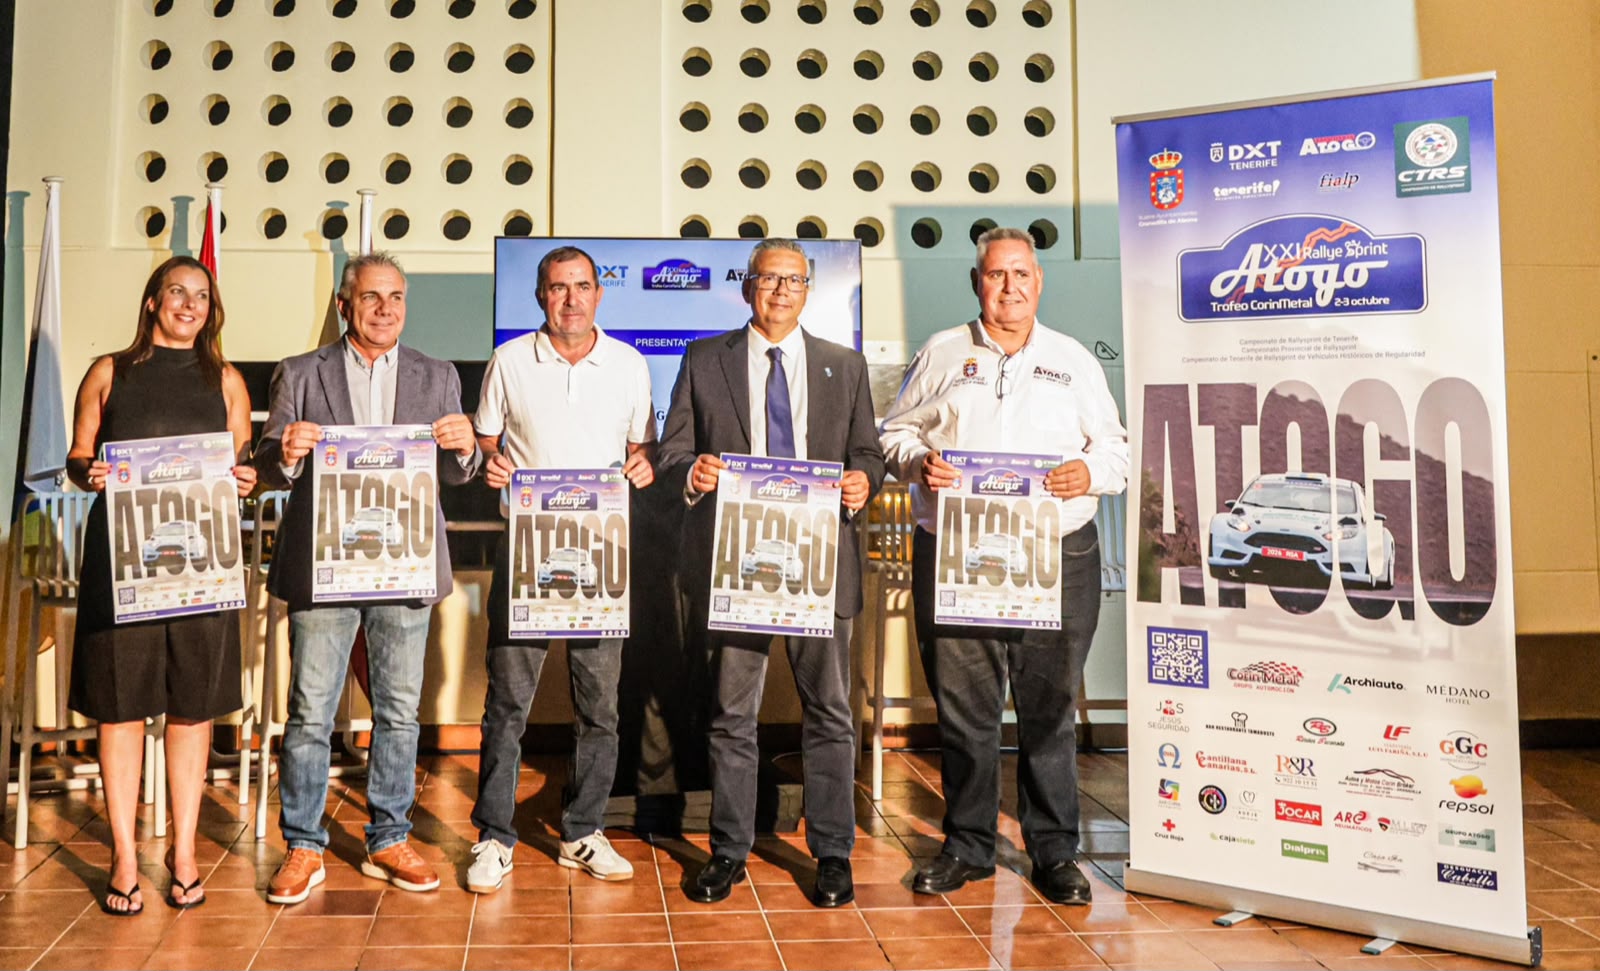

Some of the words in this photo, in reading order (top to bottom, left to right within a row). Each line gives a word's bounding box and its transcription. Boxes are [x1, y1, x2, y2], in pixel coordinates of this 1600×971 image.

[1228, 141, 1281, 161] DXT
[1229, 159, 1278, 171] TENERIFE
[1398, 165, 1468, 183] CTRS
[1213, 180, 1280, 198] tenerife!
[1319, 171, 1359, 189] fialp
[1264, 243, 1300, 261] XXI
[1303, 244, 1342, 261] Rallye
[1345, 242, 1388, 258] Sprint
[651, 265, 702, 287] Atogo
[1209, 243, 1389, 307] Atogo
[1210, 301, 1248, 312] Trofeo
[1250, 297, 1312, 310] CorinMetal
[1334, 298, 1349, 306] 2-3
[1351, 296, 1390, 305] octubre
[1239, 338, 1277, 346] Campeonato
[1288, 336, 1321, 345] Rallysprint
[1323, 344, 1357, 352] Rallysprint
[1181, 356, 1218, 364] Campeonato
[1263, 354, 1296, 362] Rallysprint
[354, 449, 397, 467] Atogo
[148, 462, 193, 480] Atogo
[758, 480, 801, 500] Atogo
[979, 474, 1023, 493] Atogo
[548, 490, 590, 509] Atogo
[1136, 376, 1498, 626] ATOGO
[316, 471, 434, 561] ATOGO
[114, 480, 239, 581] ATOGO
[713, 501, 837, 597] ATOGO
[938, 496, 1060, 589] ATOGO
[512, 513, 627, 599] ATOGO
[1227, 668, 1260, 681] Corin
[1262, 671, 1300, 687] Metal
[1426, 684, 1490, 700] MÉDANO
[1445, 697, 1471, 705] HOTEL
[1147, 721, 1190, 733] SEGURIDAD
[1439, 736, 1488, 758] GGC
[1195, 750, 1247, 766] Cantillana
[1275, 754, 1317, 776] R&R
[1277, 805, 1320, 821] JOCAR
[1438, 799, 1494, 815] repsol
[1154, 832, 1169, 840] Cruz
[1169, 834, 1184, 842] Roja
[1219, 834, 1256, 846] cajasiete
[1443, 864, 1493, 876] DESGUACES
